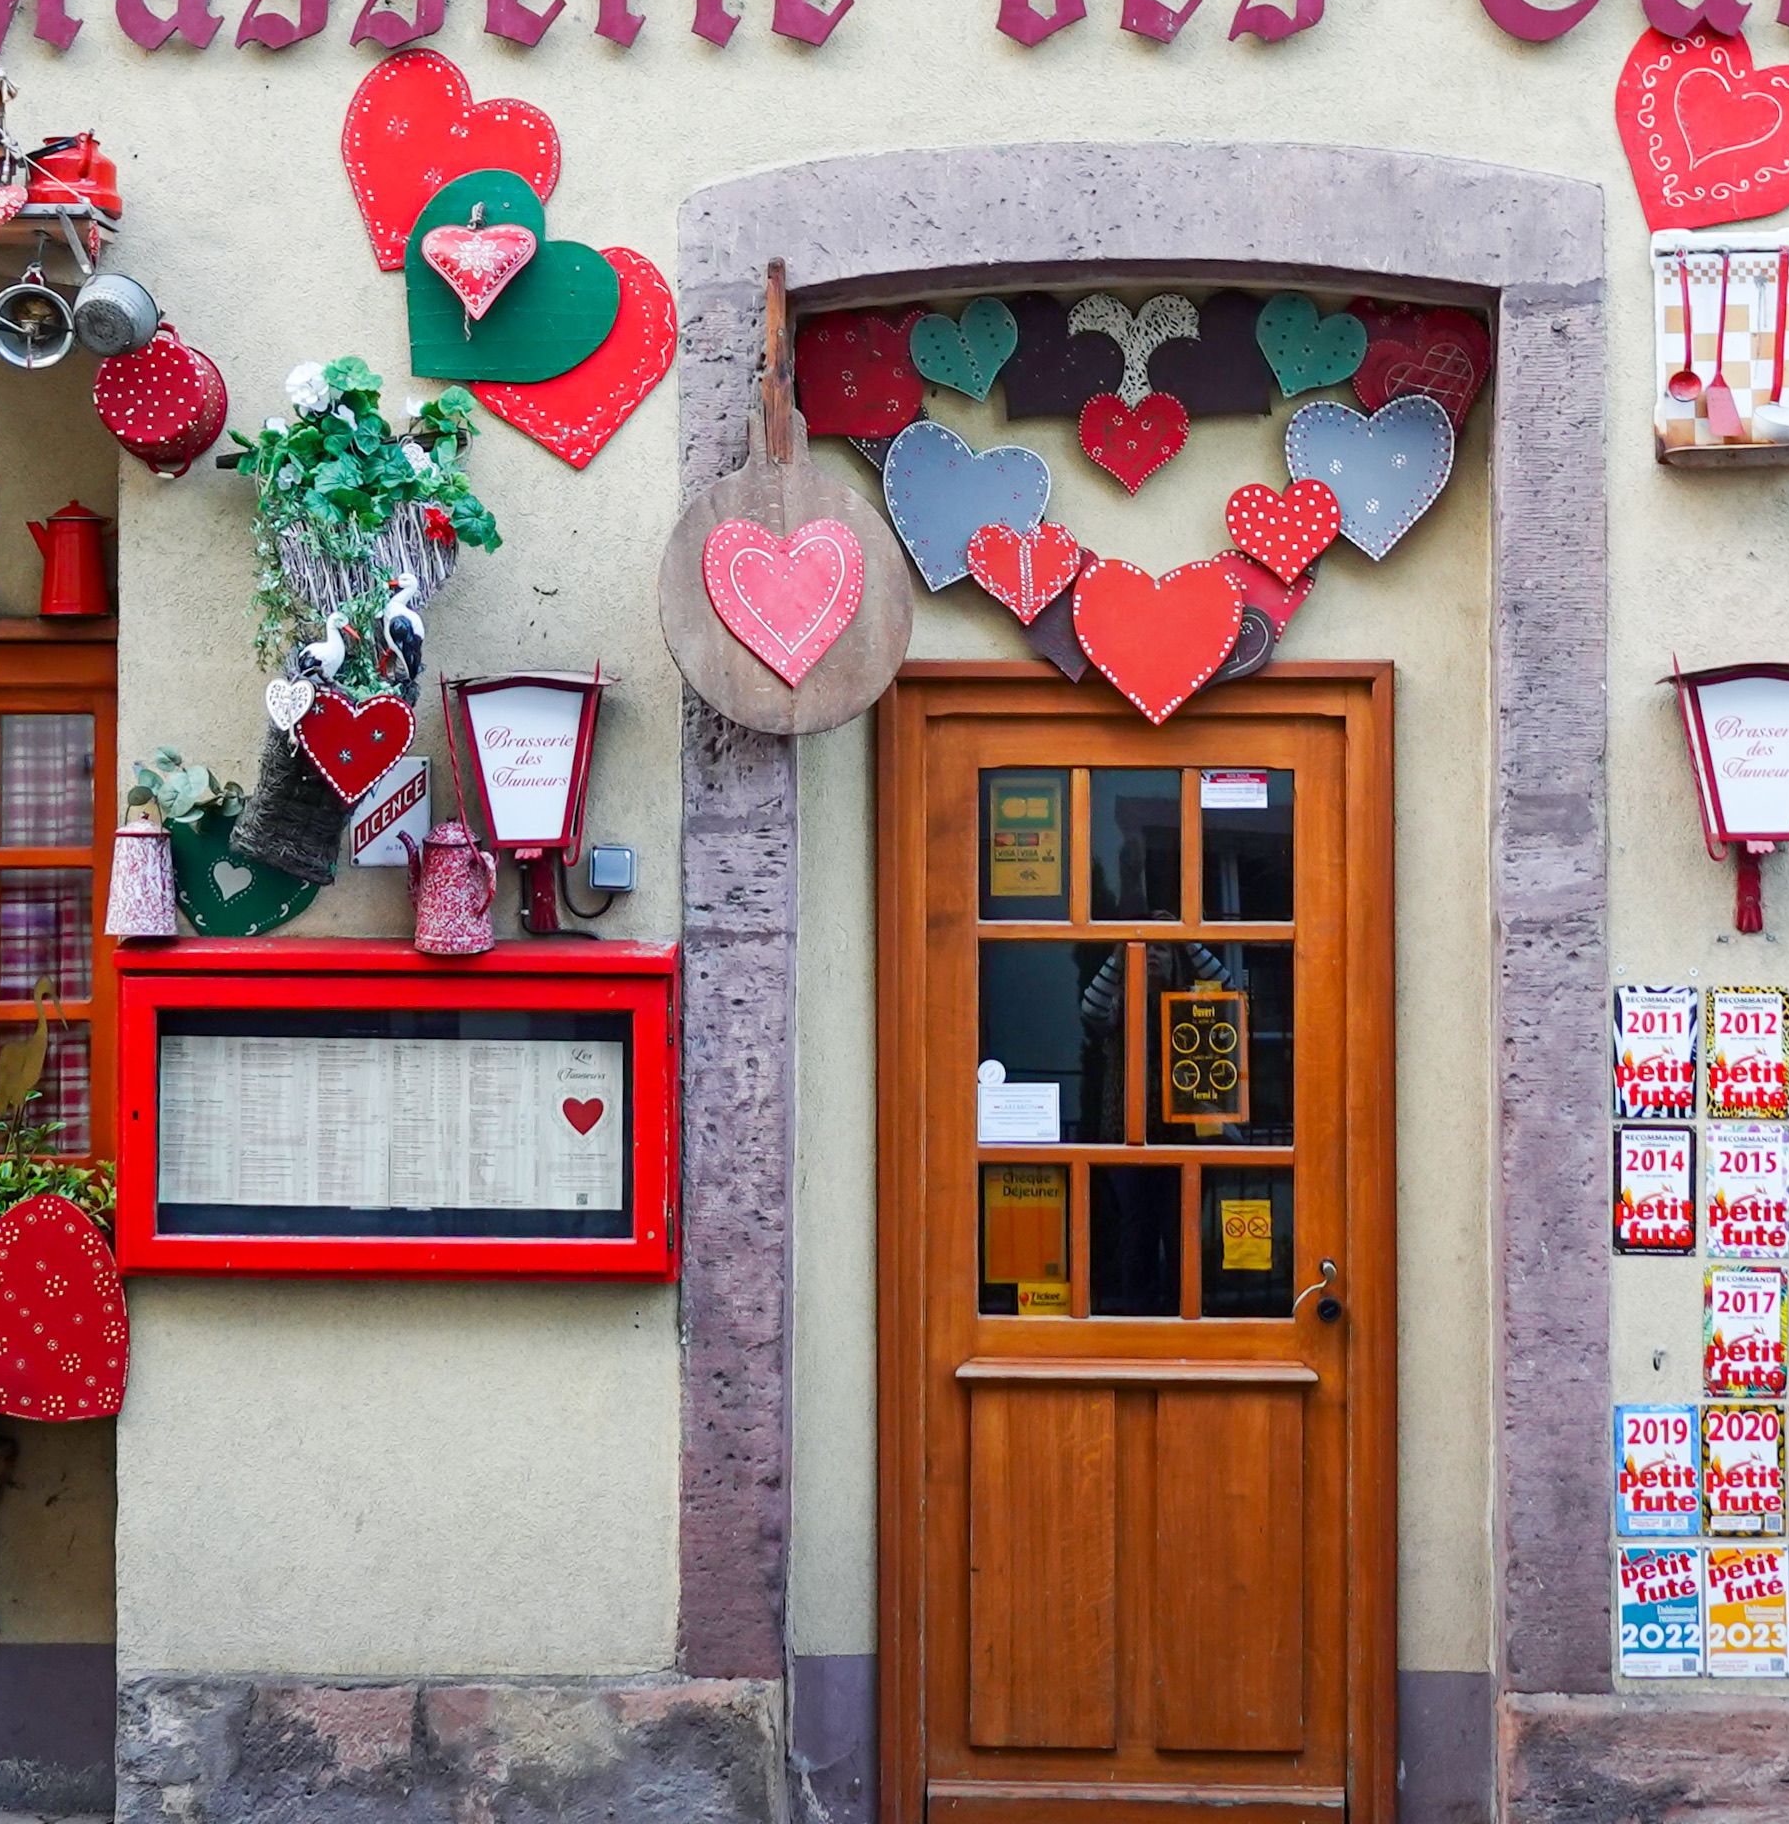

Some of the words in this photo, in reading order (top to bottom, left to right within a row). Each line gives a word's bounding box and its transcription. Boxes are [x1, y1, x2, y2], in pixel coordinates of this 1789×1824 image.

[481, 725, 574, 750] Brasserie
[1746, 741, 1774, 756] des
[515, 750, 543, 766] des
[490, 766, 568, 788] Tanneurs
[357, 775, 424, 849] LICENCE
[1625, 996, 1686, 1004] RECOMMANDÉ
[1627, 1011, 1682, 1033] 2011
[1720, 1012, 1777, 1034] 2012
[1615, 1059, 1694, 1088] petit
[1710, 1060, 1786, 1088] petit
[1629, 1083, 1693, 1108] futé
[1722, 1084, 1787, 1108] futé
[1718, 1135, 1778, 1143] RECOMMANDÉ
[1626, 1149, 1684, 1171] 2014
[1720, 1151, 1777, 1173] 2015
[1615, 1197, 1694, 1226] petit
[1709, 1199, 1787, 1227] petit
[1629, 1221, 1693, 1246] futé
[1722, 1223, 1786, 1246] futé
[1717, 1291, 1775, 1313] 2017
[1706, 1339, 1785, 1368] petit
[1720, 1363, 1784, 1389] futé
[1627, 1418, 1687, 1444] 2019
[1708, 1413, 1779, 1441] 2020
[1619, 1464, 1696, 1494] petit
[1706, 1465, 1781, 1493] petit
[1621, 1552, 1692, 1588] petit
[1708, 1553, 1779, 1588] petit
[1636, 1575, 1696, 1603] futé
[1723, 1575, 1783, 1603] futé
[1622, 1622, 1700, 1649] 2022
[1710, 1622, 1787, 1648] 2023
